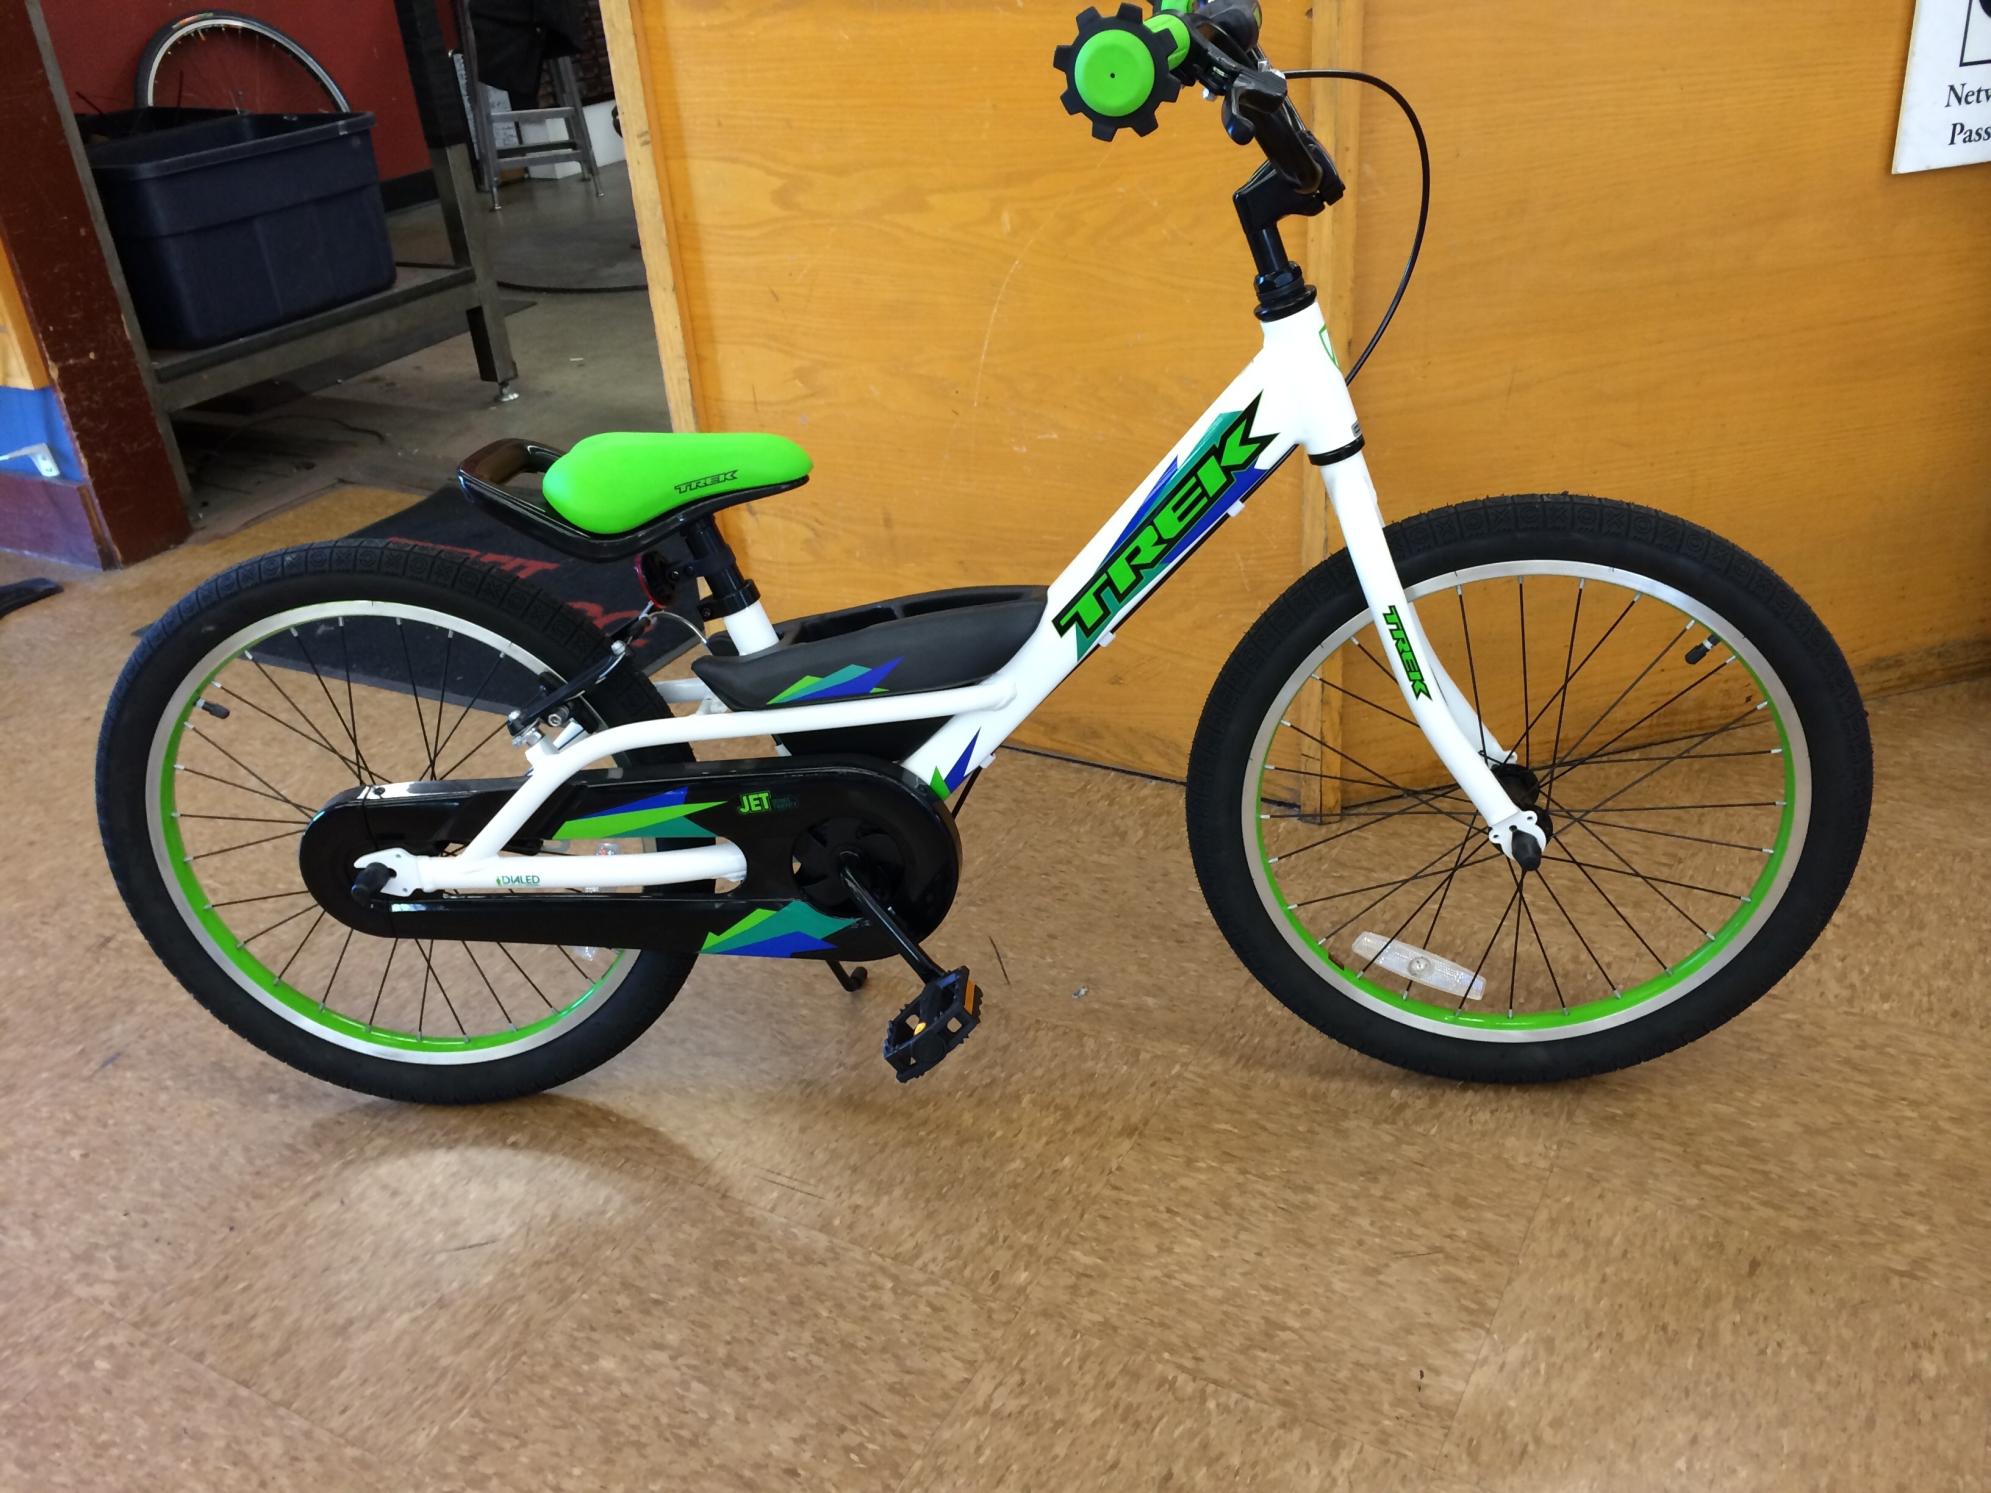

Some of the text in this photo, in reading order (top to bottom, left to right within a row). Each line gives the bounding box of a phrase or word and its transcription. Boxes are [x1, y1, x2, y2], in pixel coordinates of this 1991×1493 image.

[1948, 122, 1991, 146] Pass
[674, 469, 738, 494] TREK
[1052, 389, 1280, 639] TREK
[1382, 605, 1433, 701] TREK
[739, 792, 770, 813] JET
[501, 875, 541, 885] DIALED
